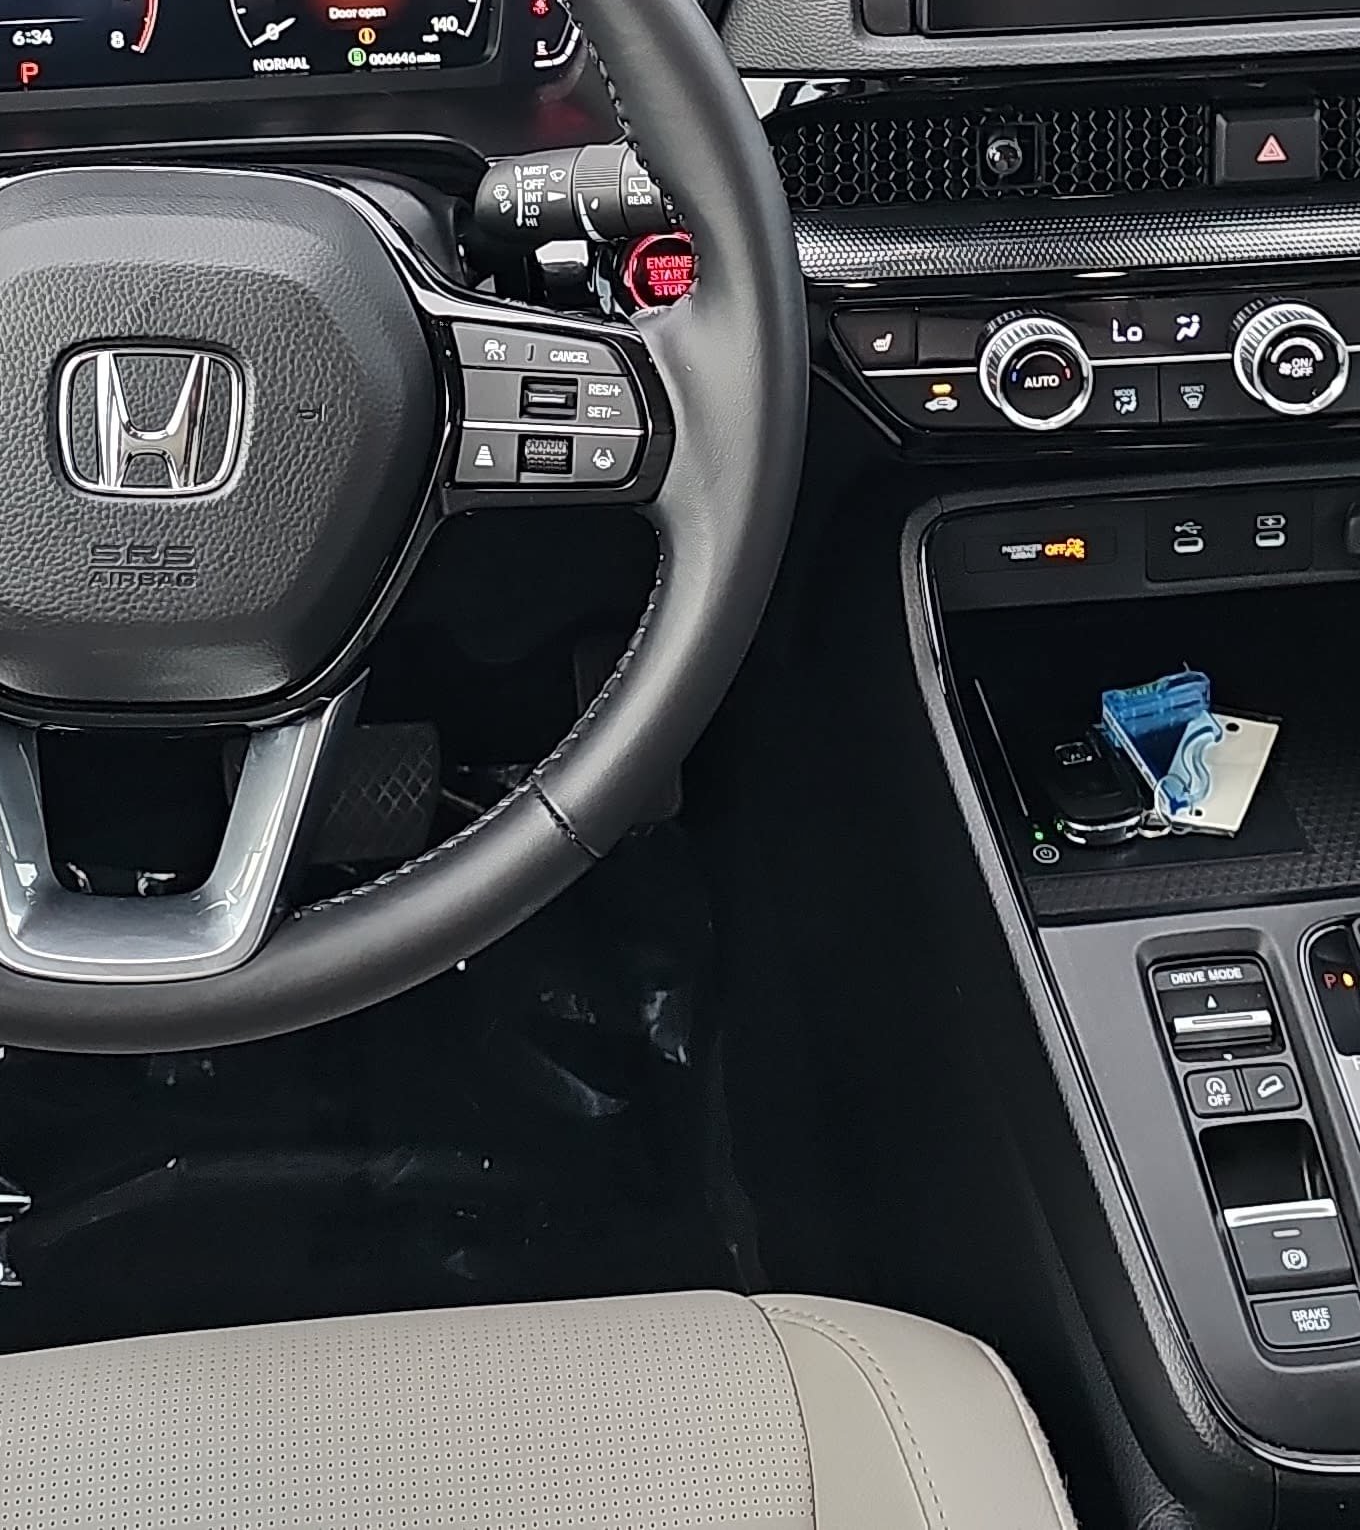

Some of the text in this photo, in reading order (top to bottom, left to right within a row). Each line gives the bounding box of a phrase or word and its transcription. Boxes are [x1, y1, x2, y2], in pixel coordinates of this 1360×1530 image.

[328, 7, 387, 21] Door open
[430, 16, 458, 32] 140
[12, 30, 53, 46] 6:34
[110, 32, 125, 49] 8
[252, 57, 310, 72] NORMAL
[20, 61, 39, 84] P
[522, 165, 549, 176] MIST
[523, 178, 546, 190] OFF
[524, 191, 543, 203] INT
[627, 195, 653, 206] REAR
[524, 205, 540, 216] LO
[525, 217, 538, 227] HI
[646, 255, 693, 270] ENGINE
[649, 269, 691, 281] START
[653, 284, 687, 297] STOP
[1112, 318, 1144, 343] Lo
[549, 350, 590, 364] CANCEL
[1291, 356, 1314, 368] ON/
[1291, 366, 1314, 378] OFF
[1023, 374, 1060, 389] AUTO
[588, 383, 622, 397] RES/+
[90, 544, 196, 567] SRS
[1044, 543, 1067, 557] OFF
[88, 571, 197, 589] AIRBAG
[1170, 967, 1243, 985] DRIVE MODE
[1323, 972, 1337, 989] P
[1207, 1093, 1232, 1107] OFF
[1291, 1307, 1331, 1323] BRAKE
[1297, 1319, 1331, 1332] HOLD
